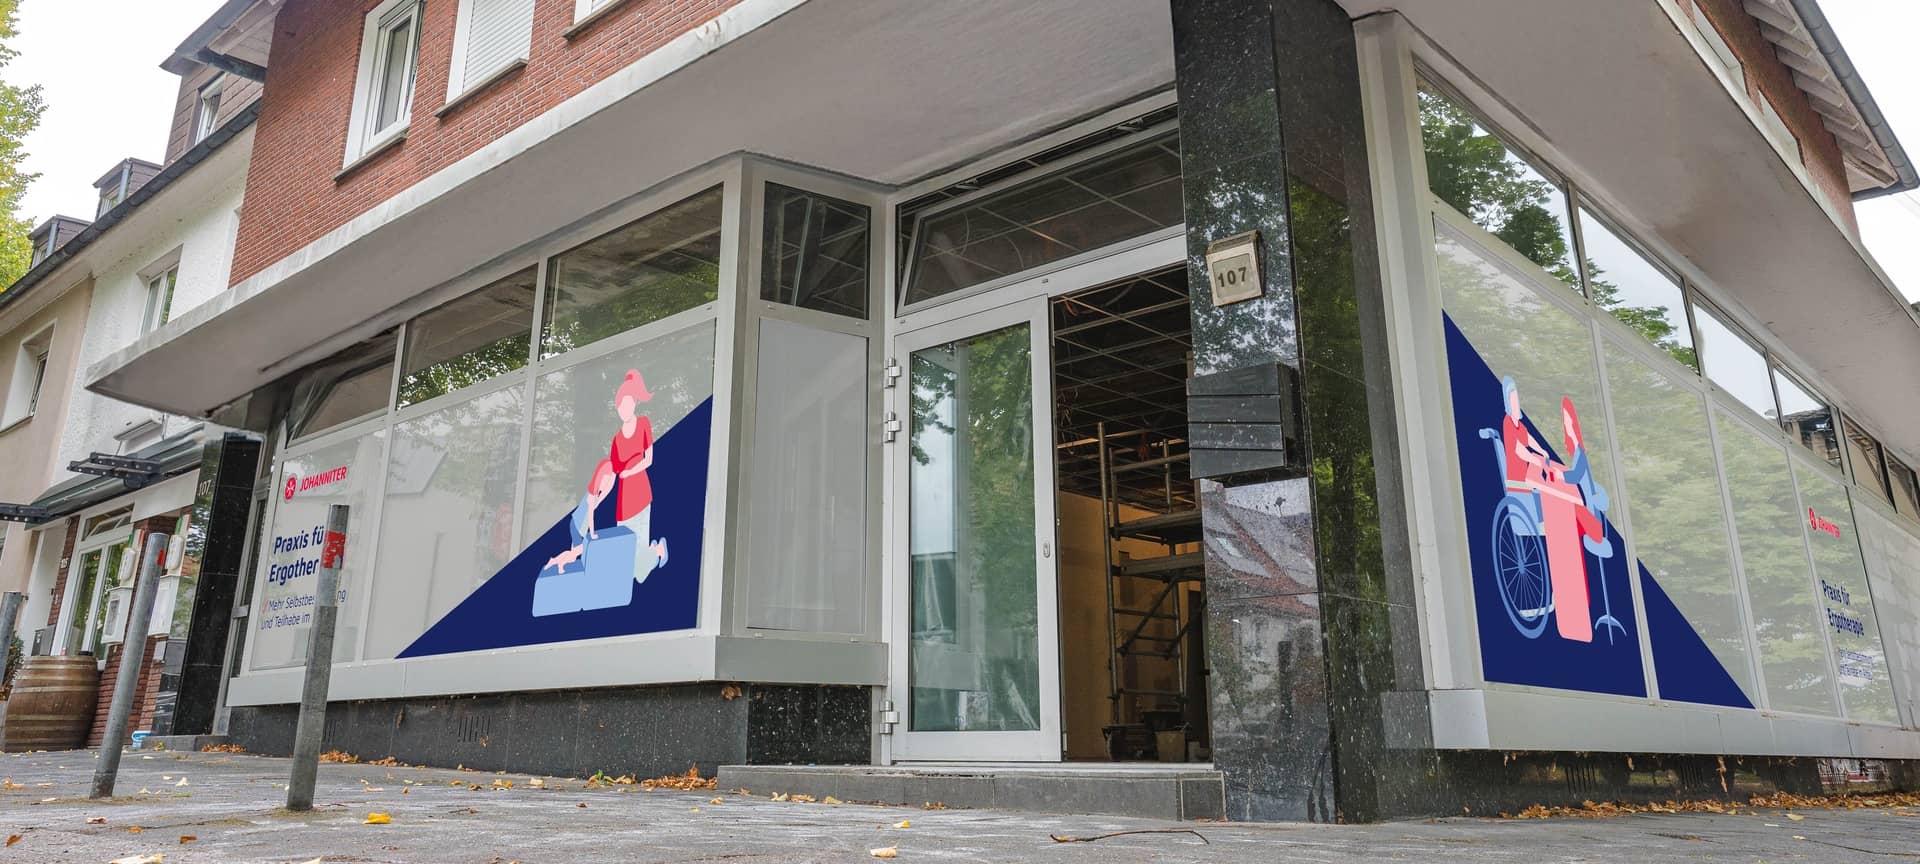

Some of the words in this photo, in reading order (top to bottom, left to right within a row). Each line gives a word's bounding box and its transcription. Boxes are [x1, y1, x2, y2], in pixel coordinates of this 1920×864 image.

[1218, 267, 1247, 287] 107
[300, 466, 347, 492] JOHANNITER
[274, 530, 309, 554] Praxis
[312, 525, 324, 546] fü
[269, 557, 320, 586] Ergother
[1821, 578, 1841, 604] Praxis
[270, 598, 284, 611] Mehr
[1827, 608, 1864, 638] Ergotherapie
